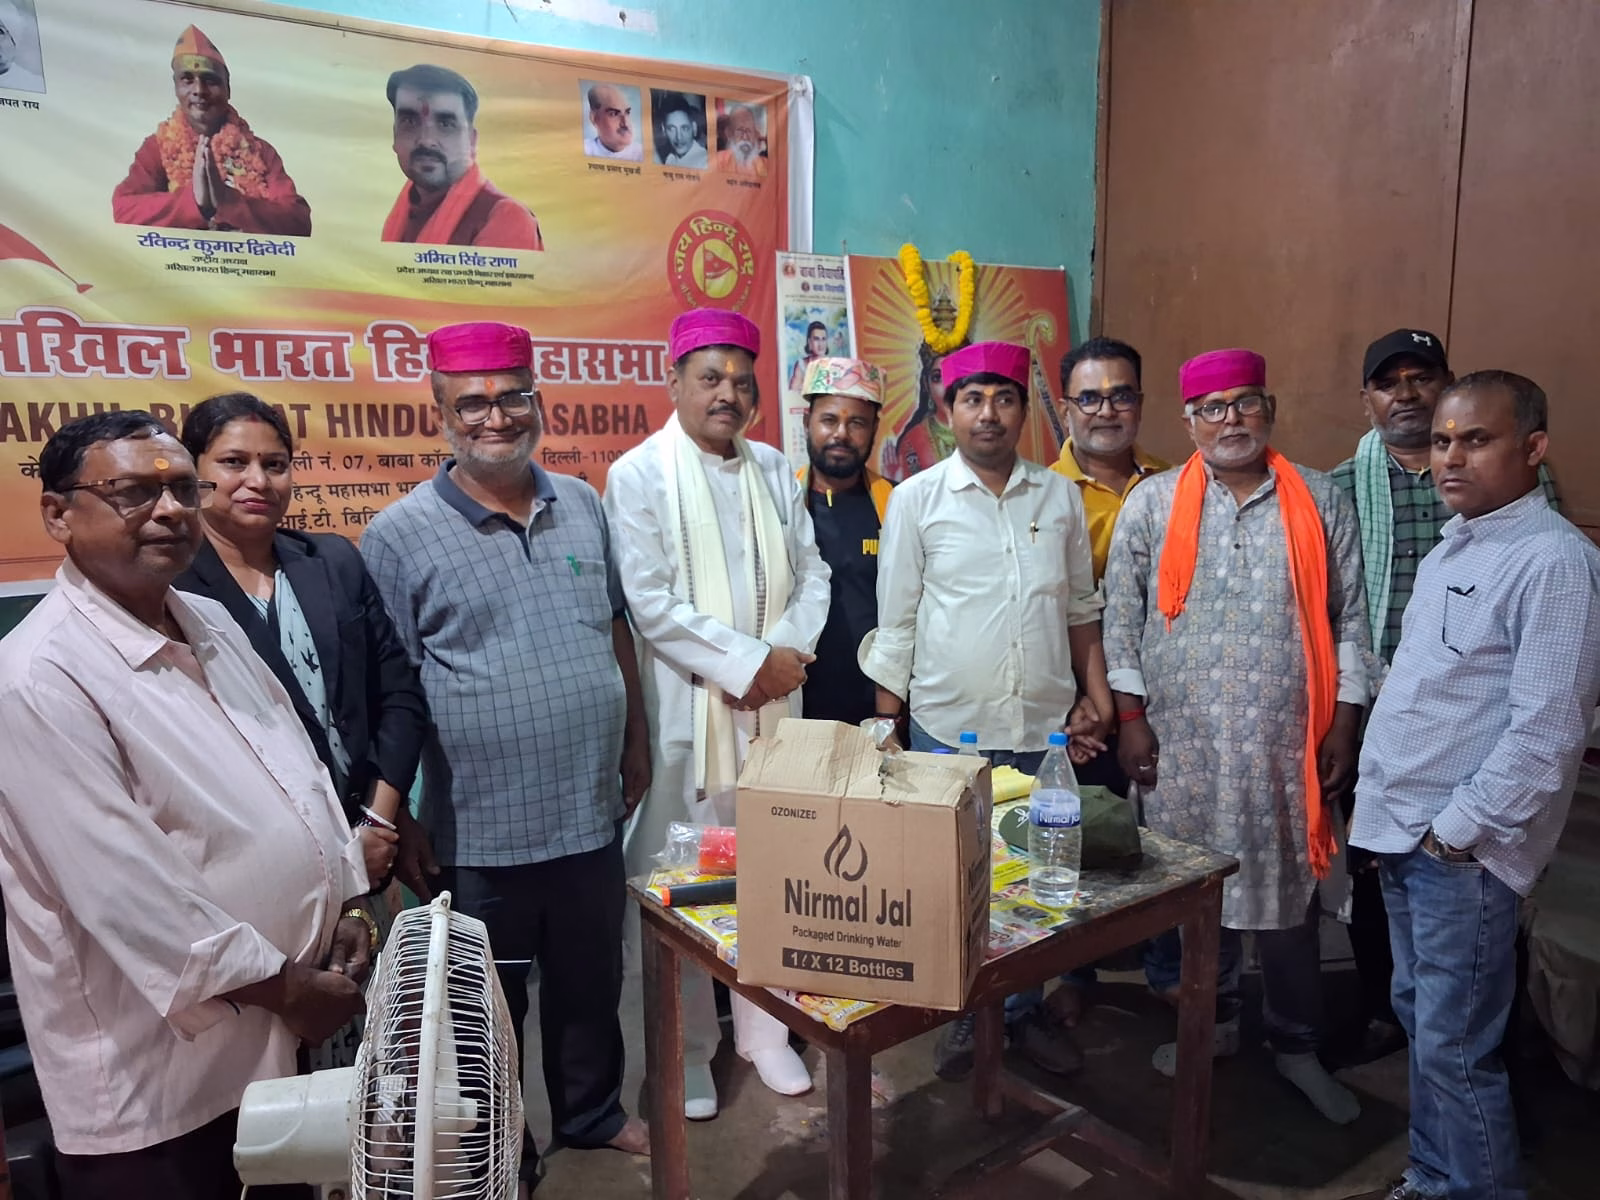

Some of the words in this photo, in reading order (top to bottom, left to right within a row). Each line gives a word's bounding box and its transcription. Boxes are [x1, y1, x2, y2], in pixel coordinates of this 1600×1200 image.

[21, 100, 40, 111] राय
[137, 232, 191, 250] रविन्द्र
[194, 238, 244, 256] कुमार
[246, 239, 296, 257] द्विवेदी
[674, 231, 693, 273] जय
[414, 249, 456, 265] अमित
[458, 251, 487, 268] सिंह
[489, 257, 518, 269] राणा
[209, 329, 354, 381] भारत
[530, 337, 669, 385] हासभा
[318, 451, 336, 471] नं.
[377, 454, 414, 469] बाबा
[326, 482, 391, 499] महासभा
[862, 538, 880, 555] PU
[771, 806, 817, 820] OZONIZED
[1040, 812, 1070, 824] Nirmal
[784, 878, 867, 923] Nirmal
[875, 888, 911, 927] Jal
[792, 925, 834, 942] Packaged
[836, 931, 875, 948] Drinking
[876, 935, 902, 948] Water
[811, 954, 821, 969] X
[826, 957, 844, 972] 12
[848, 959, 904, 978] Bottles
